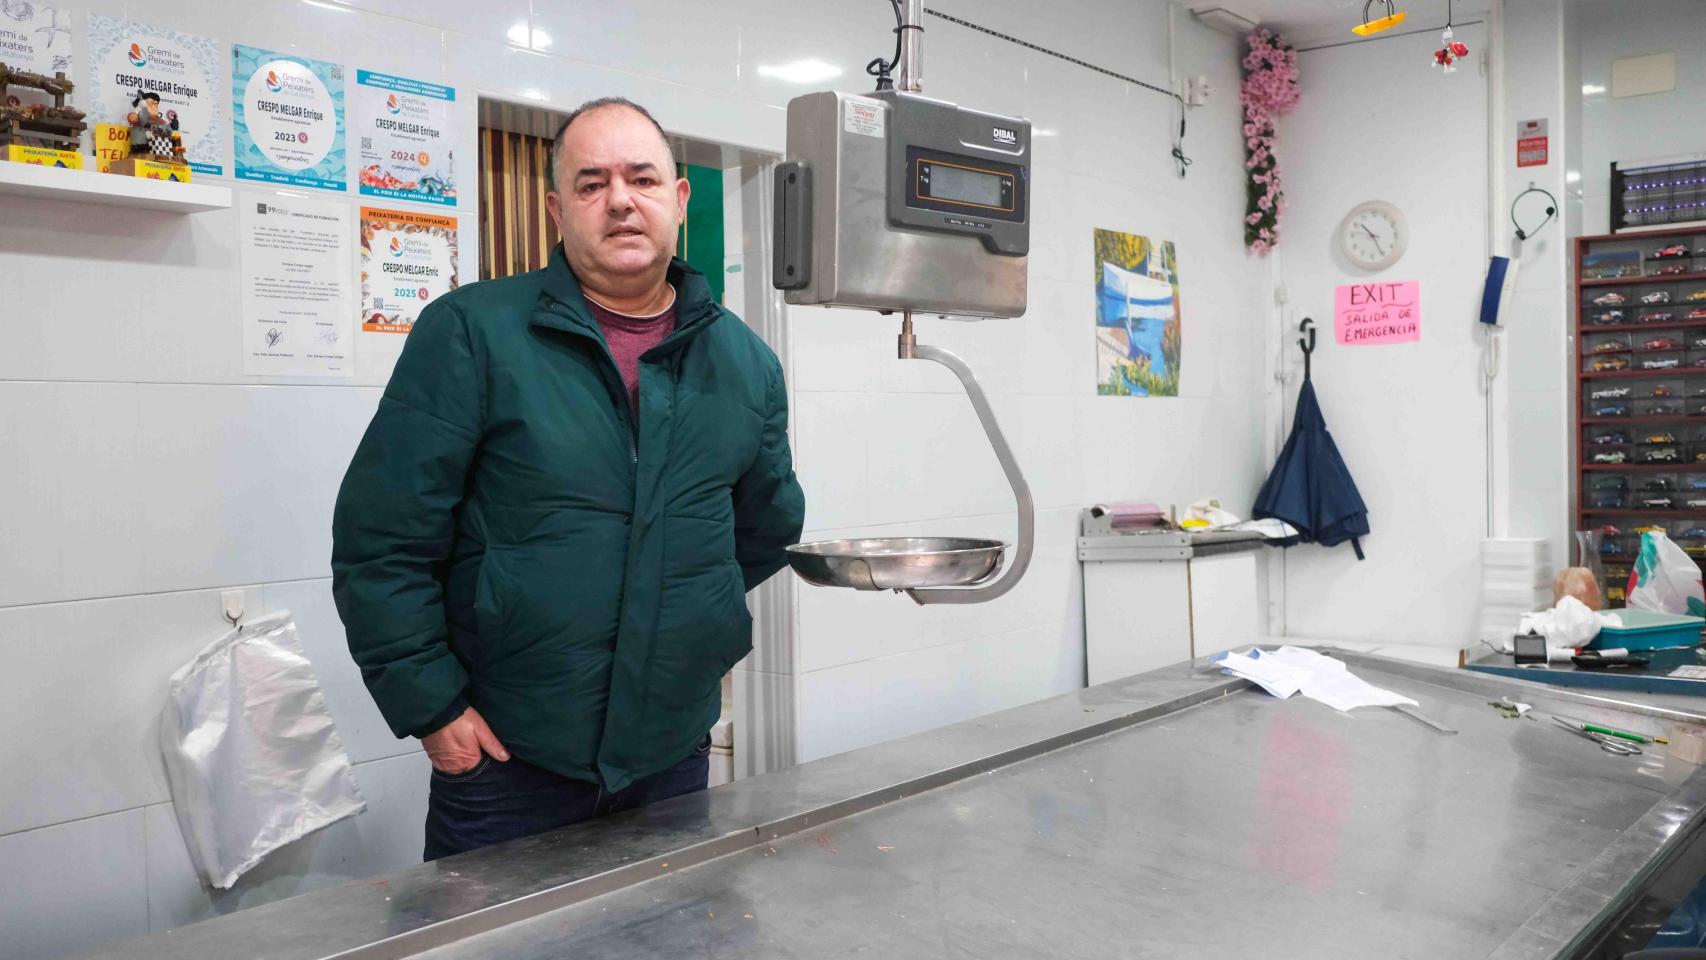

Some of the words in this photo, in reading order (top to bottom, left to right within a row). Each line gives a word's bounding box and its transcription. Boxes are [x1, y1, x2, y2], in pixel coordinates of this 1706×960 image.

[147, 45, 172, 57] Gremi
[147, 55, 185, 69] Peixaters
[282, 73, 304, 83] Gremi
[115, 73, 143, 89] CRESPO
[144, 78, 172, 93] MELGAR
[173, 84, 198, 99] Enrique
[282, 81, 315, 94] Peixaters
[257, 100, 279, 113] CRESPO
[280, 104, 303, 118] MELGAR
[303, 108, 323, 122] Enrique
[375, 118, 397, 131] CRESPO
[397, 121, 420, 134] MELGAR
[420, 126, 440, 138] Enrique
[993, 127, 1016, 141] DIBAL
[274, 131, 296, 142] 2023
[391, 150, 415, 162] 2024
[368, 211, 404, 221] PEIXATERIA
[415, 216, 450, 226] CONFIANÇA
[382, 262, 404, 274] CRESPO
[425, 266, 439, 277] Enric
[394, 288, 417, 298] 2025
[1350, 283, 1404, 305] EXIT
[1344, 311, 1389, 326] SALIDA
[1398, 308, 1412, 319] DE
[1344, 322, 1417, 342] EMERGENCIA
